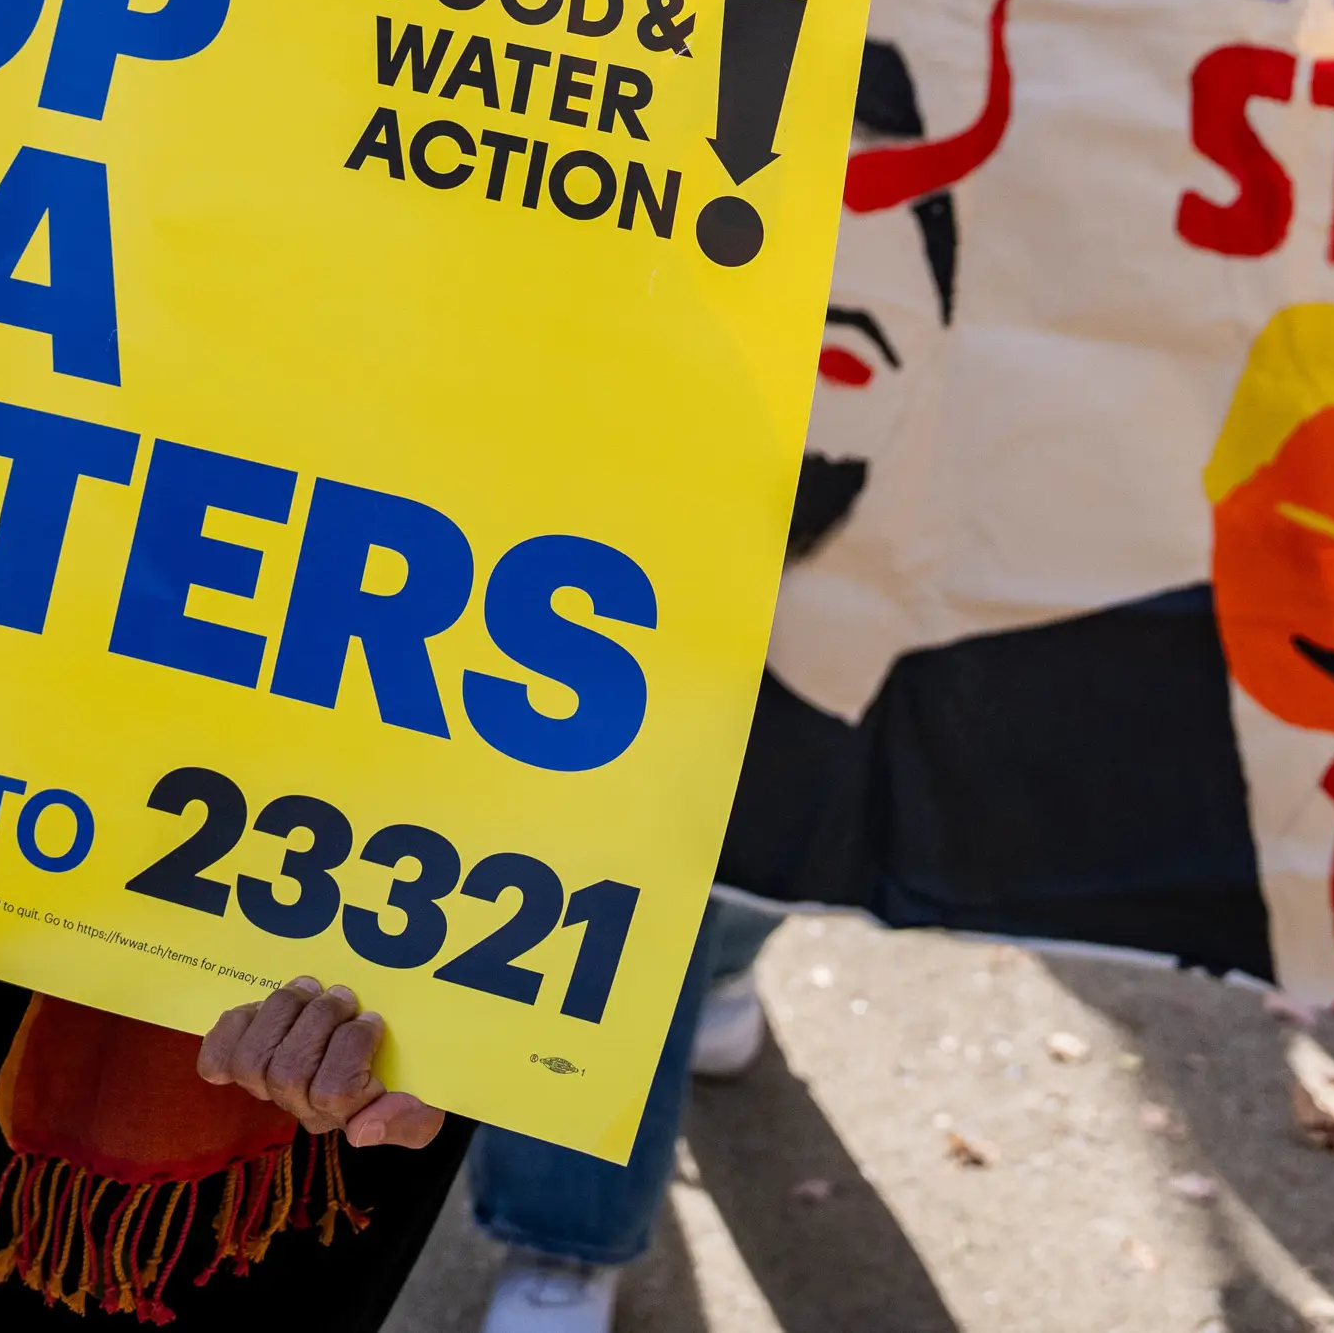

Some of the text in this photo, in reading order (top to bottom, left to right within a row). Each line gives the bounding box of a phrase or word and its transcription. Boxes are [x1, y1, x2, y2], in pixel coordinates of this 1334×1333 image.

[376, 16, 653, 141] WATER
[344, 107, 682, 239] ACTION
[3, 901, 14, 913] to
[17, 907, 40, 921] quit.
[44, 912, 61, 926] Go
[63, 919, 74, 930] to
[76, 921, 199, 967] https://fwwat.ch/terms
[200, 958, 217, 972] for
[217, 965, 258, 986] privacy
[259, 977, 282, 991] and
[124, 767, 640, 1024] 23321
